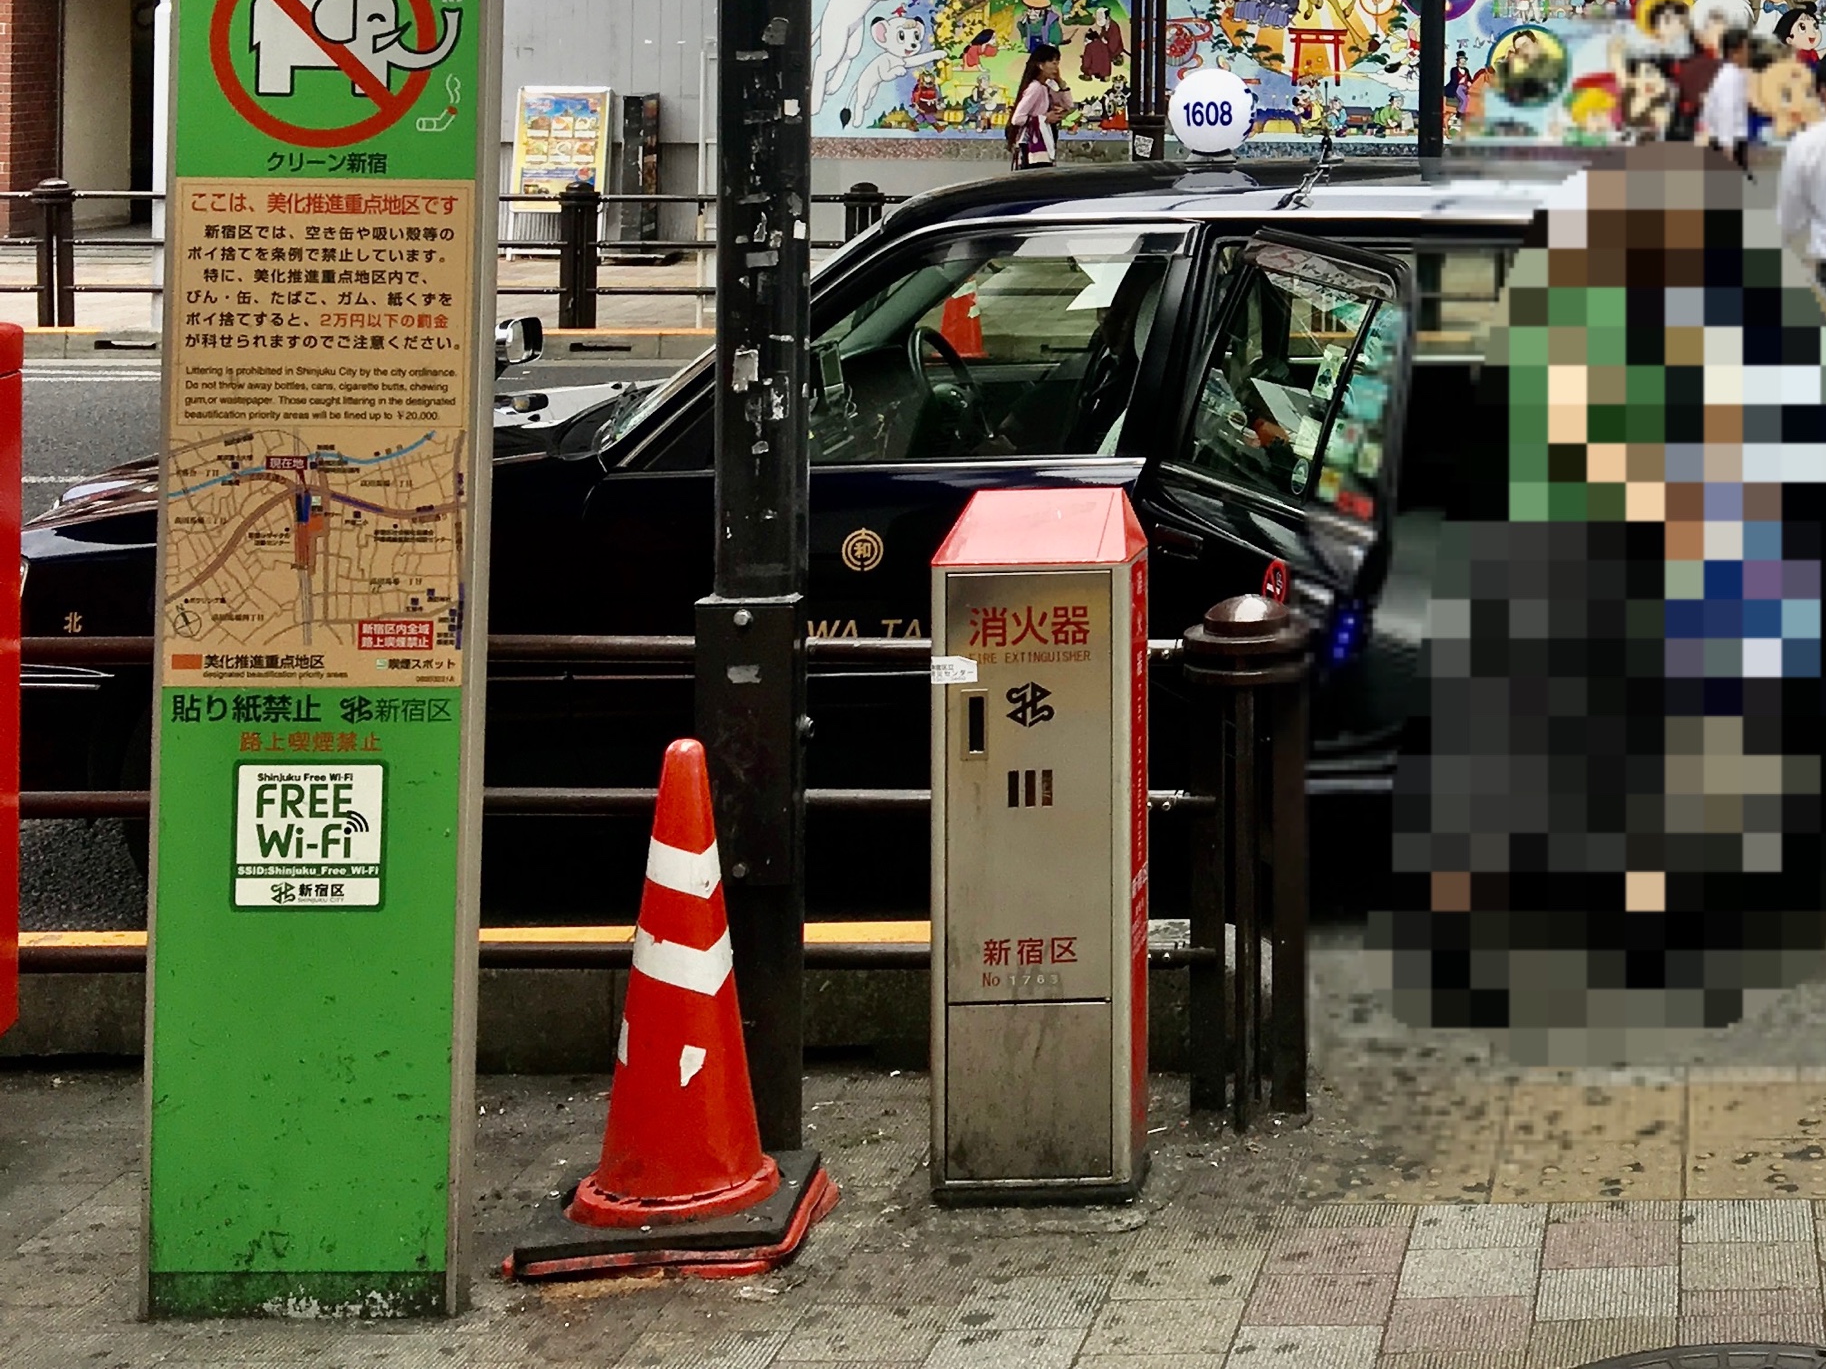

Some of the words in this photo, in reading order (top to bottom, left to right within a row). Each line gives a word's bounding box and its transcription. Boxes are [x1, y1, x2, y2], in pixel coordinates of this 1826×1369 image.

[1184, 101, 1233, 127] 1608
[267, 152, 388, 174] クリーン新宿
[191, 193, 459, 215] ここは、美化推進重点地区です
[204, 225, 455, 241] 新宿区では、空き缶や吸い殻等の
[187, 247, 447, 263] ポイ捨てを条例で禁止しています。
[203, 268, 429, 285] 特に、美化推進重点地区内で、
[185, 334, 460, 351] が科せられますのでご注意ください。
[186, 366, 223, 377] Littering
[226, 366, 233, 374] is
[236, 366, 283, 376] prohibited
[296, 367, 336, 377] Shinjuku
[339, 367, 357, 377] City
[360, 367, 370, 377] by
[374, 367, 388, 376] the
[391, 367, 407, 377] city
[186, 381, 198, 389] Do
[202, 381, 216, 389] not
[219, 381, 244, 389] throw
[247, 382, 272, 391] away
[339, 383, 378, 392] cigarette
[410, 383, 448, 392] chewing
[278, 396, 306, 404] Those
[309, 397, 340, 406] caught
[343, 397, 376, 407] littering
[378, 397, 387, 405] in
[389, 397, 403, 405] the
[405, 397, 456, 407] designated
[185, 411, 246, 419] beautification
[249, 411, 280, 421] priority
[312, 411, 327, 419] will
[329, 411, 341, 419] be
[344, 411, 367, 419] fined
[369, 413, 381, 421] up
[270, 458, 304, 469] 現在地
[64, 611, 83, 633] 北
[362, 623, 430, 635] 新宿区内全域
[969, 606, 1091, 648] 消火器
[361, 637, 429, 648] 路上喫煙禁止
[204, 654, 325, 669] 美化推進重点地区
[388, 658, 456, 670] 喫煙スポット
[1005, 651, 1091, 663] EXTINGUISHER
[299, 671, 324, 679] priority
[171, 694, 321, 724] 貼り紙禁止
[375, 697, 452, 723] 新宿区
[240, 732, 382, 753] 路上喫煙禁止
[257, 773, 301, 782] Shinjuku
[303, 773, 327, 781] Free
[330, 773, 353, 781] Wi-Fi
[256, 783, 353, 818] FREE
[256, 824, 351, 858] Wi-Fi
[299, 884, 344, 897] 新宿区
[983, 937, 1078, 966] 新宿区
[982, 972, 1000, 987] No
[1009, 975, 1059, 985] 1763
